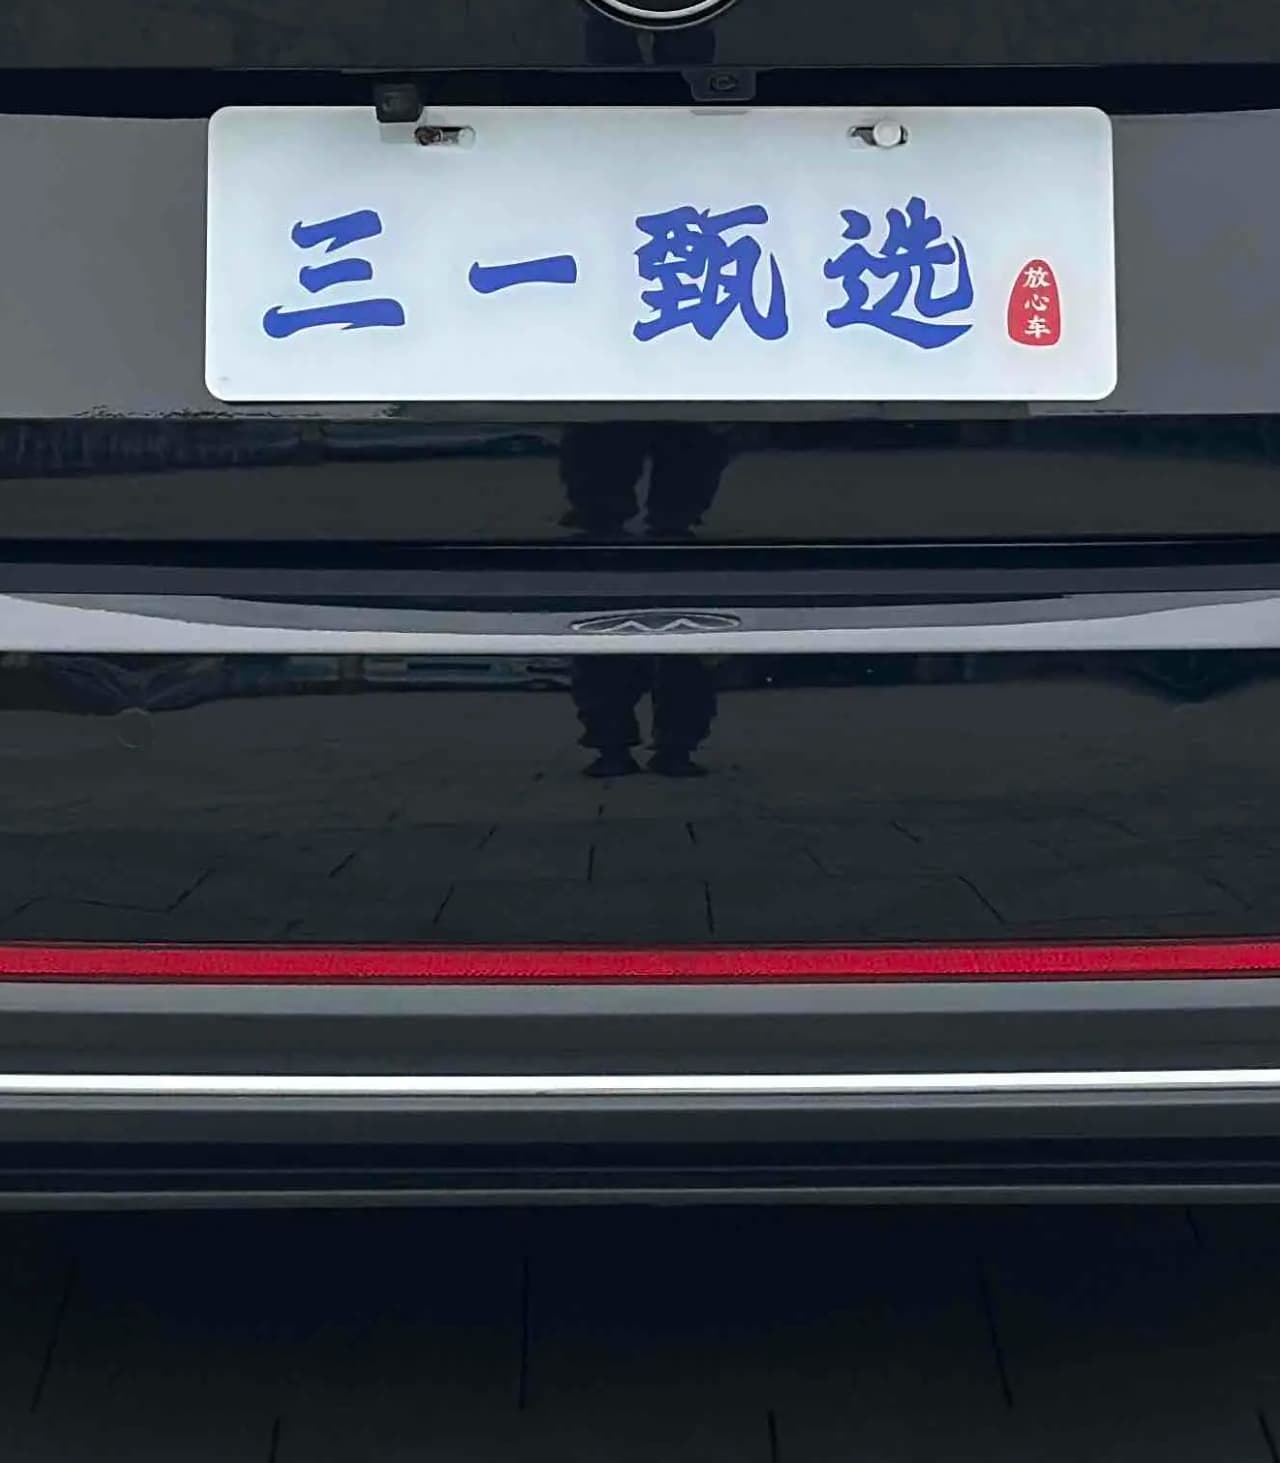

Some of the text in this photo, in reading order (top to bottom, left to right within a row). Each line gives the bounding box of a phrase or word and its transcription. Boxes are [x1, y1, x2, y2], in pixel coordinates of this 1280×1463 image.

[262, 196, 974, 349] 三一甄选
[1022, 266, 1051, 339] 放心车
